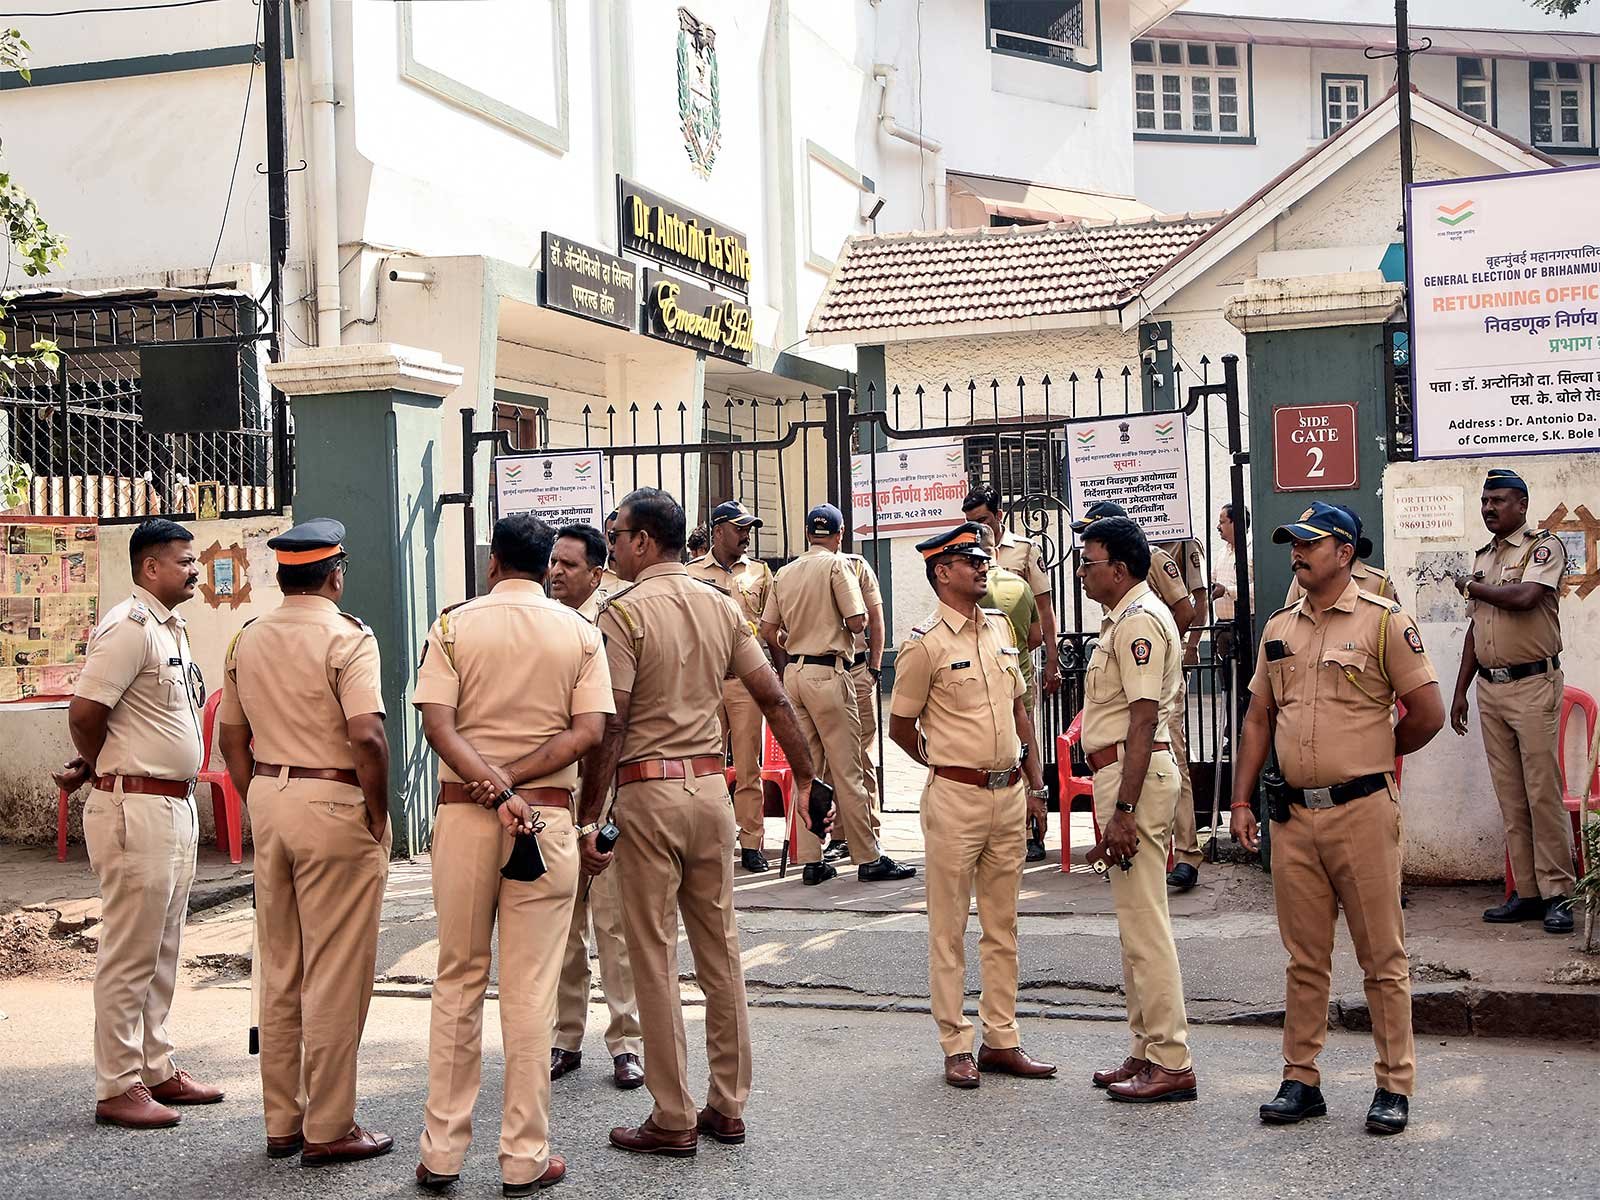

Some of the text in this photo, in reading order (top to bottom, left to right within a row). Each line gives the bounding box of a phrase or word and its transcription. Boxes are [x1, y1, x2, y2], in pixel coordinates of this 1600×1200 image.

[633, 195, 752, 281] Dr. Antonio da Silva
[1424, 262, 1600, 287] GENERAL ELECTION OF BRIHANMU
[1432, 284, 1599, 312] RETURNING OFFIC
[658, 280, 754, 352] Emerald Hall
[1484, 308, 1598, 335] निवडणूक निर्णय
[1549, 336, 1592, 353] प्रभाग
[1429, 381, 1451, 393] पत्ता
[1462, 376, 1478, 391] डॉ.
[1537, 374, 1554, 386] दा.
[1557, 370, 1594, 385] सिल्वा
[1511, 394, 1533, 406] एस.
[1537, 390, 1552, 404] के.
[1556, 387, 1582, 403] बोले
[1299, 416, 1330, 428] SIDE
[1449, 419, 1496, 430] Address
[1506, 417, 1523, 427] Dr.
[1526, 412, 1574, 426] Antonio
[1578, 412, 1597, 423] Da.
[1291, 428, 1339, 443] GATE
[1458, 434, 1469, 446] of
[1473, 431, 1539, 444] Commerce,
[1542, 429, 1565, 441] S.K.
[1568, 428, 1594, 440] Bole
[1113, 459, 1136, 471] सूचना
[1306, 446, 1325, 477] 2
[1106, 475, 1139, 486] निवडणूक
[537, 494, 558, 504] सूचना
[892, 484, 921, 504] निर्णय
[923, 479, 968, 502] अधिकारी
